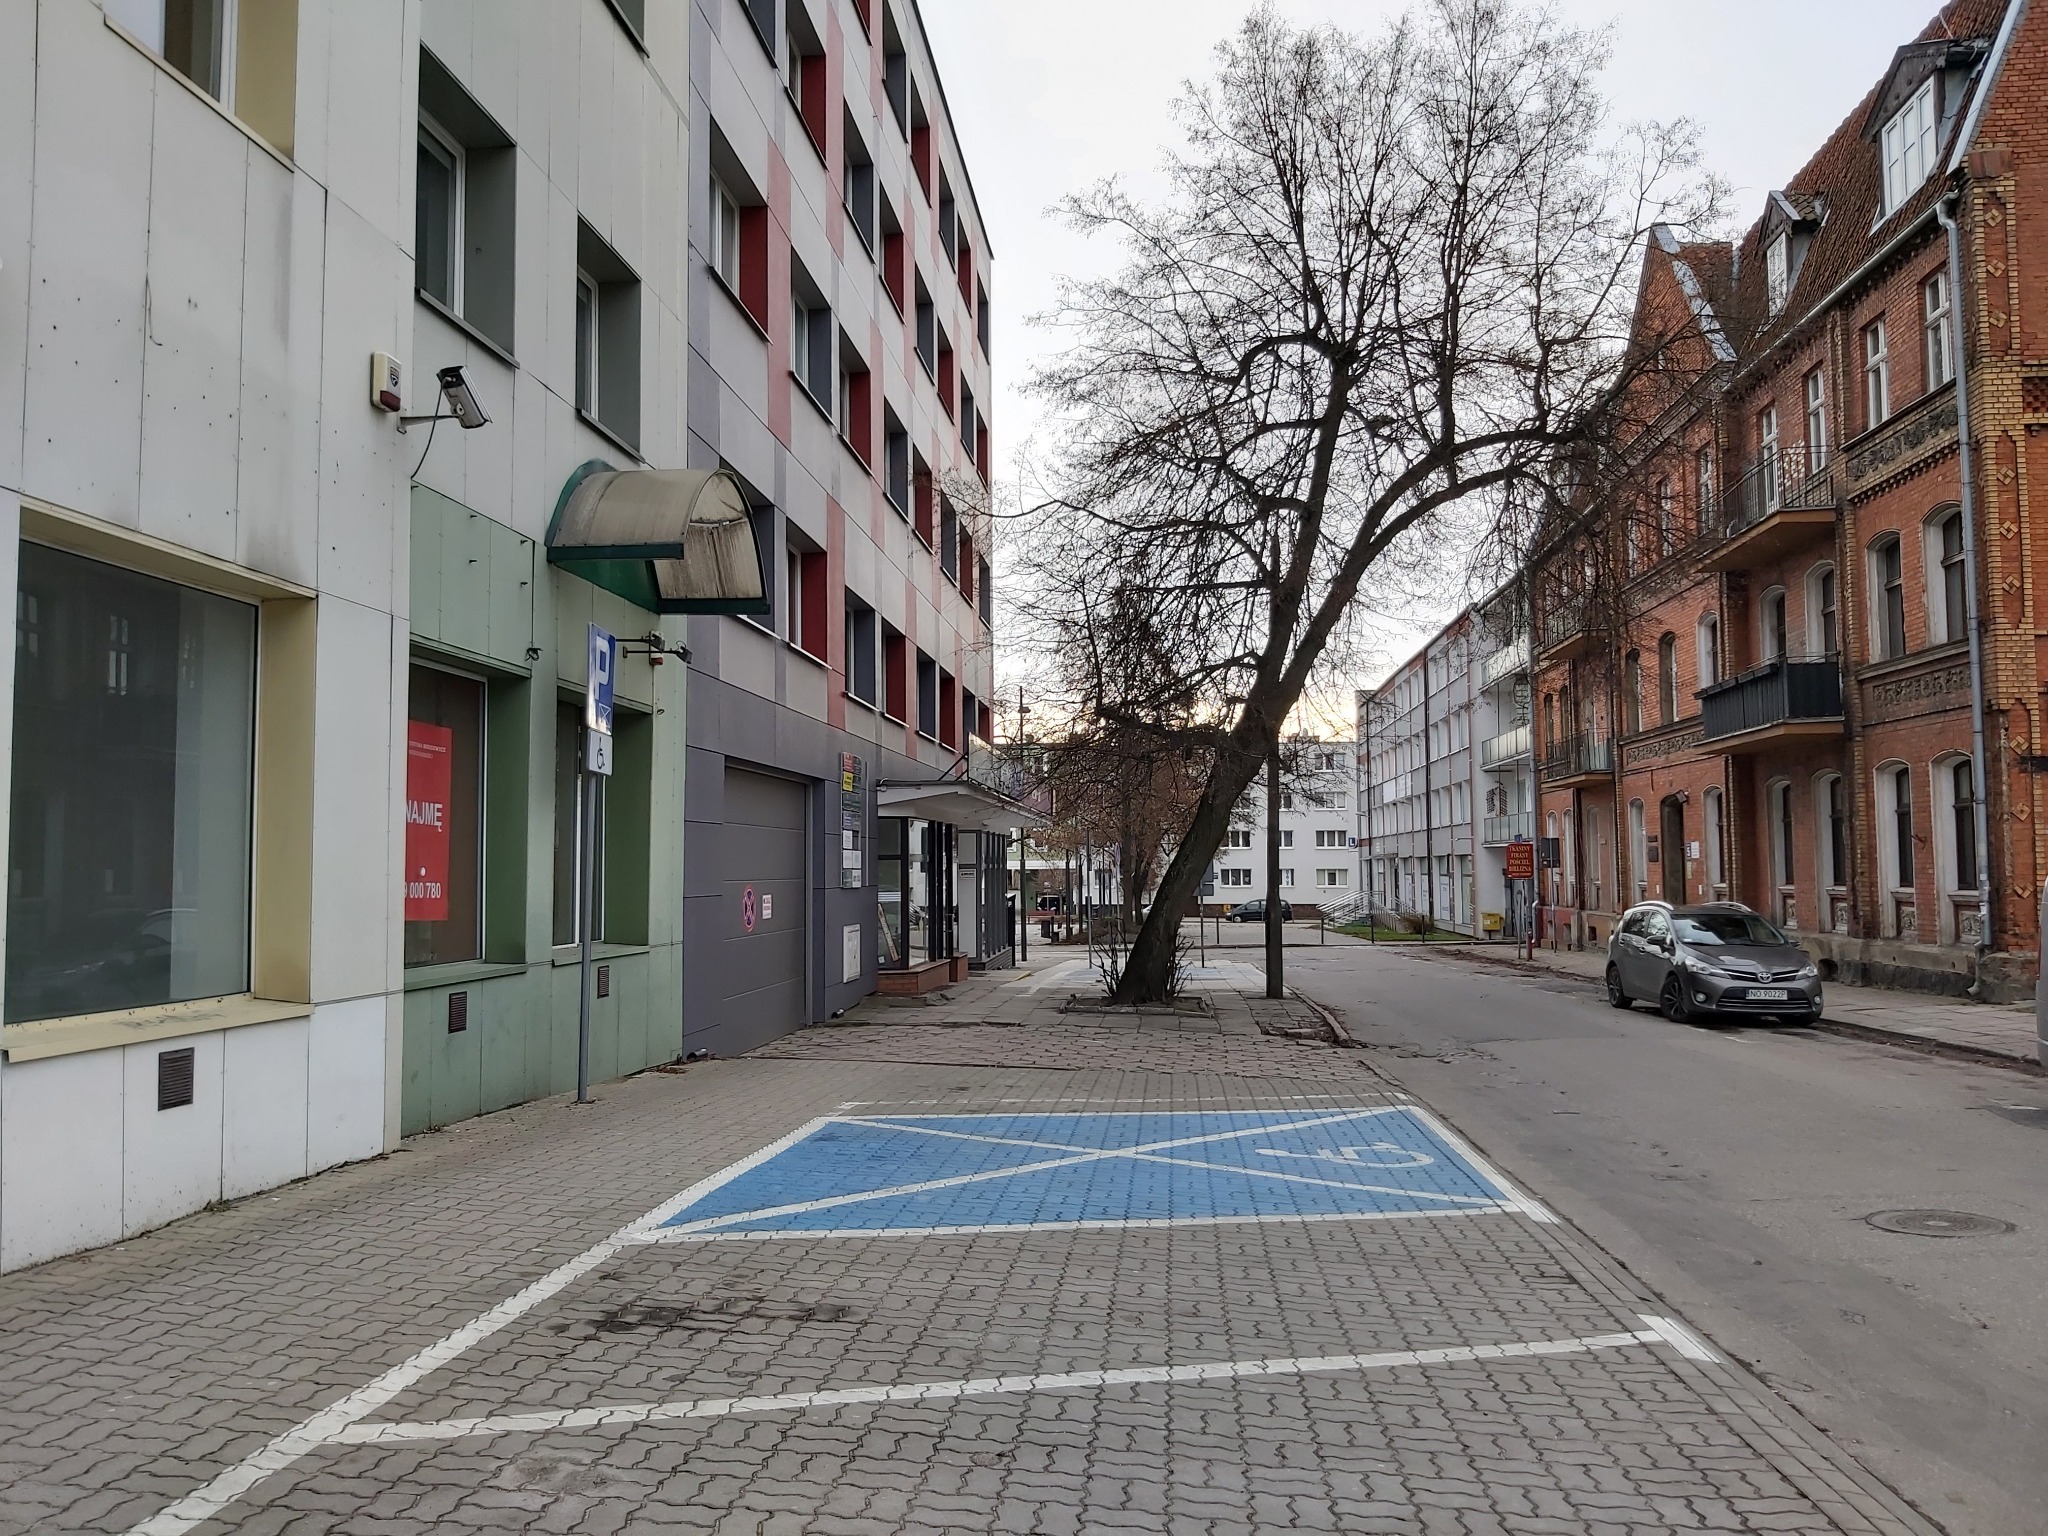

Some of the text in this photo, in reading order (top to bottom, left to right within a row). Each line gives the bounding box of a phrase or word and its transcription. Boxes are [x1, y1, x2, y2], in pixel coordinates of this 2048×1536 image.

[594, 635, 610, 700] P
[409, 882, 424, 899] 000
[426, 882, 441, 899] 780
[1750, 990, 1761, 998] NO
